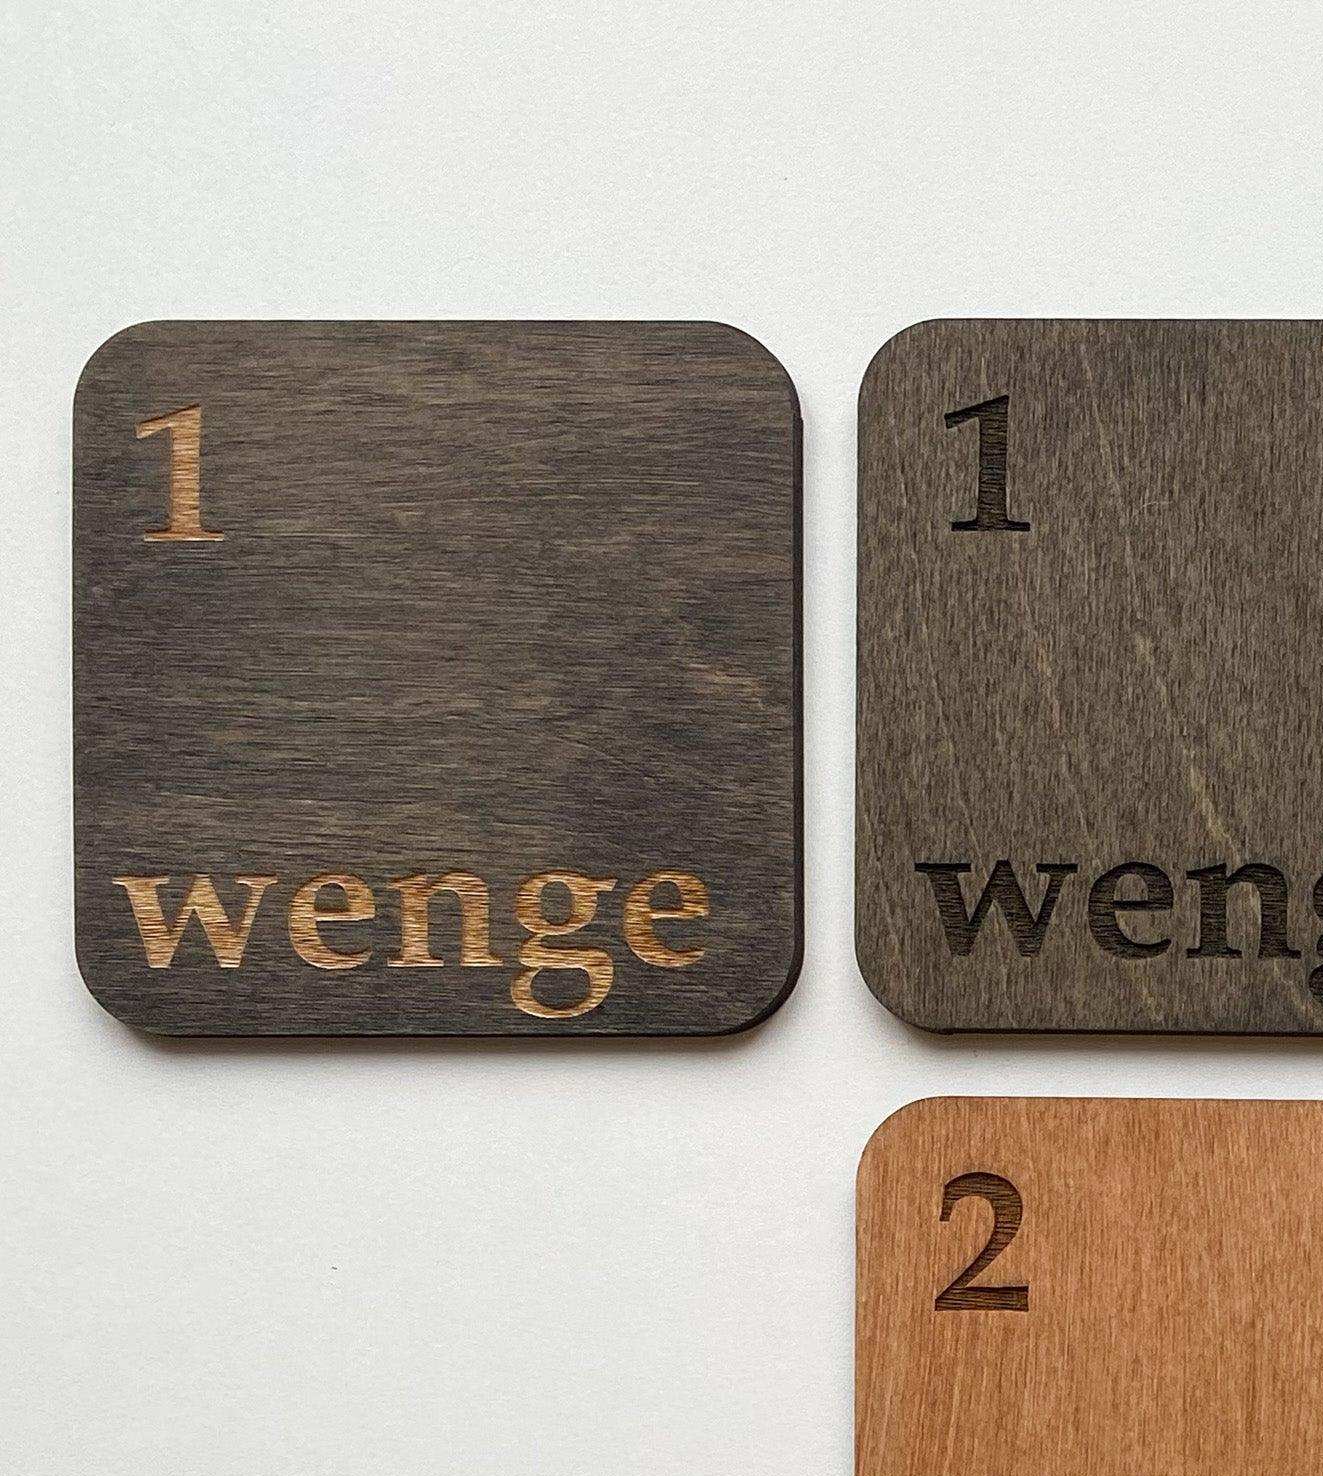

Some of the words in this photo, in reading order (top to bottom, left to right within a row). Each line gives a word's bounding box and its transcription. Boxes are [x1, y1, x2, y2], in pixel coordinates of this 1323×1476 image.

[134, 404, 224, 543] 1
[944, 394, 1029, 532] 1
[115, 869, 711, 1018] wenge
[935, 1169, 1029, 1311] 2
